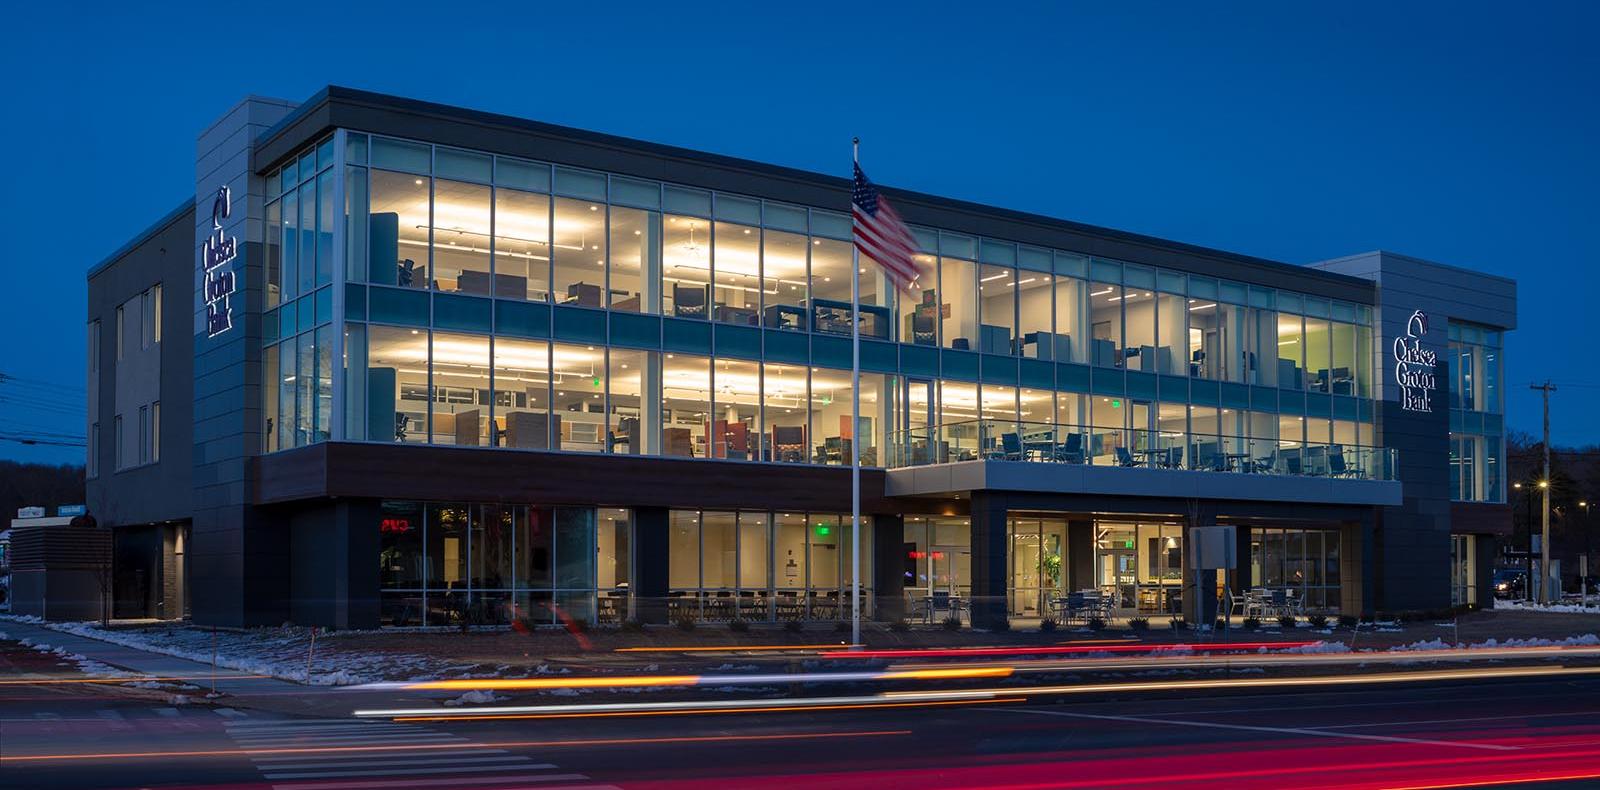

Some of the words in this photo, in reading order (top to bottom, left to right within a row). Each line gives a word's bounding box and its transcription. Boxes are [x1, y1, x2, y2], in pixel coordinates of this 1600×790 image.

[1394, 336, 1437, 367] Chelsea
[1396, 361, 1436, 389] Groton
[1402, 385, 1433, 412] Bank
